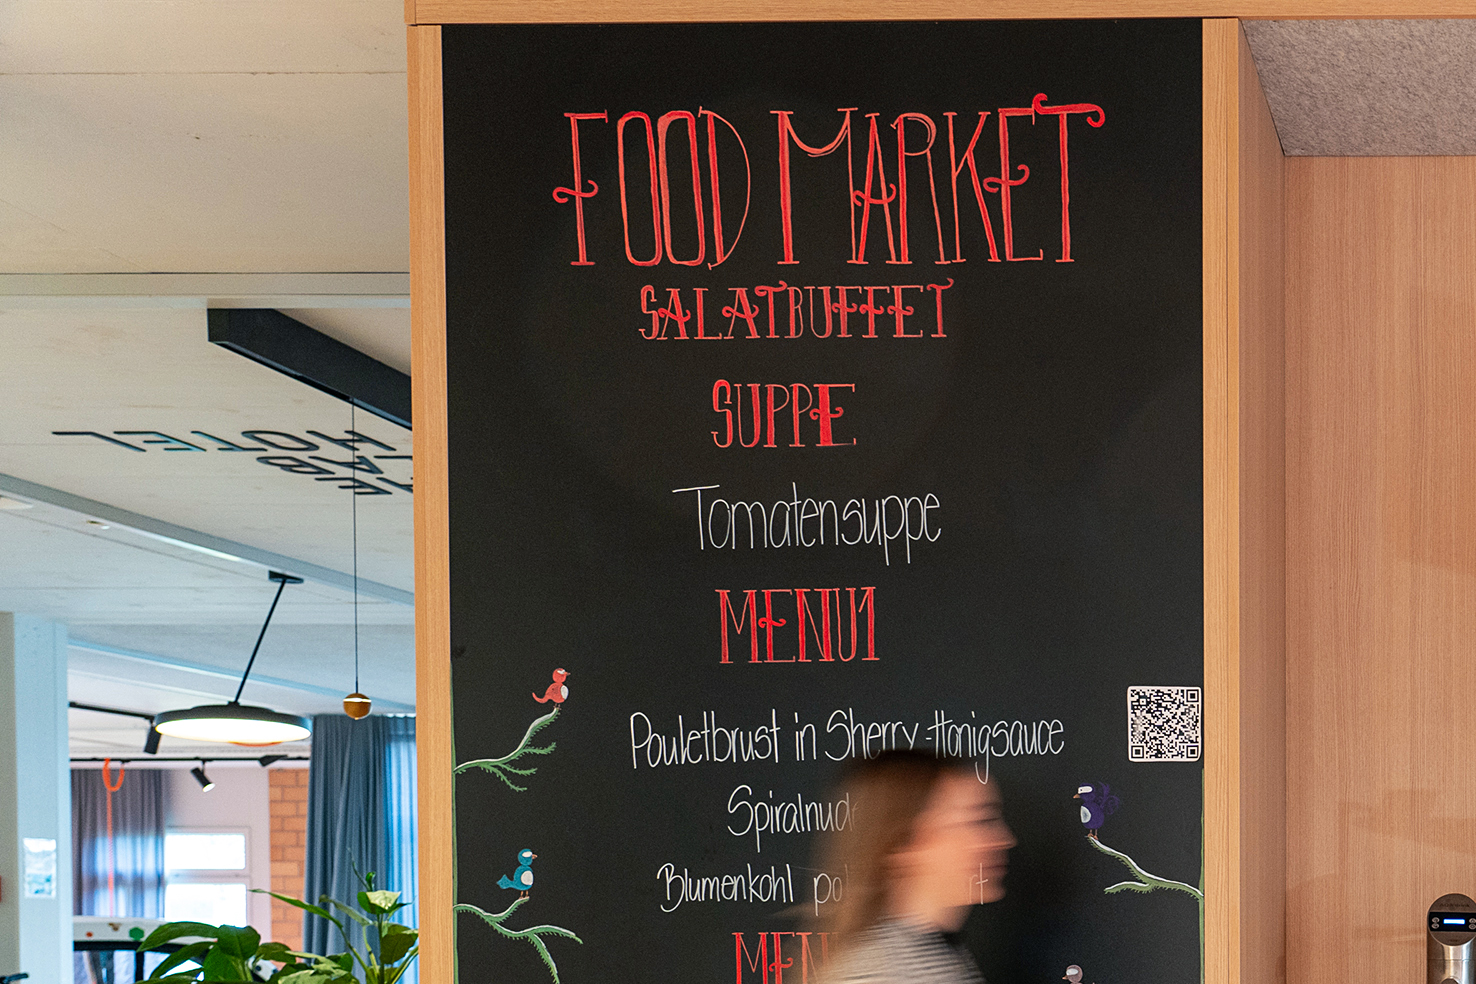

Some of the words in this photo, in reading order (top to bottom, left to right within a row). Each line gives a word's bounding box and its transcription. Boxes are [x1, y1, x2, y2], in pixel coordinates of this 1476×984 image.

[552, 106, 750, 270] FOOD
[770, 93, 1105, 264] MARKET
[639, 278, 954, 340] SALATBUFFET
[52, 430, 397, 452] HOTEL
[711, 379, 856, 448] SUPPE
[673, 482, 942, 565] Tomatensuppe
[629, 708, 781, 770] Pouletbrust
[794, 711, 817, 762] in
[656, 862, 794, 913] Blumenkohl
